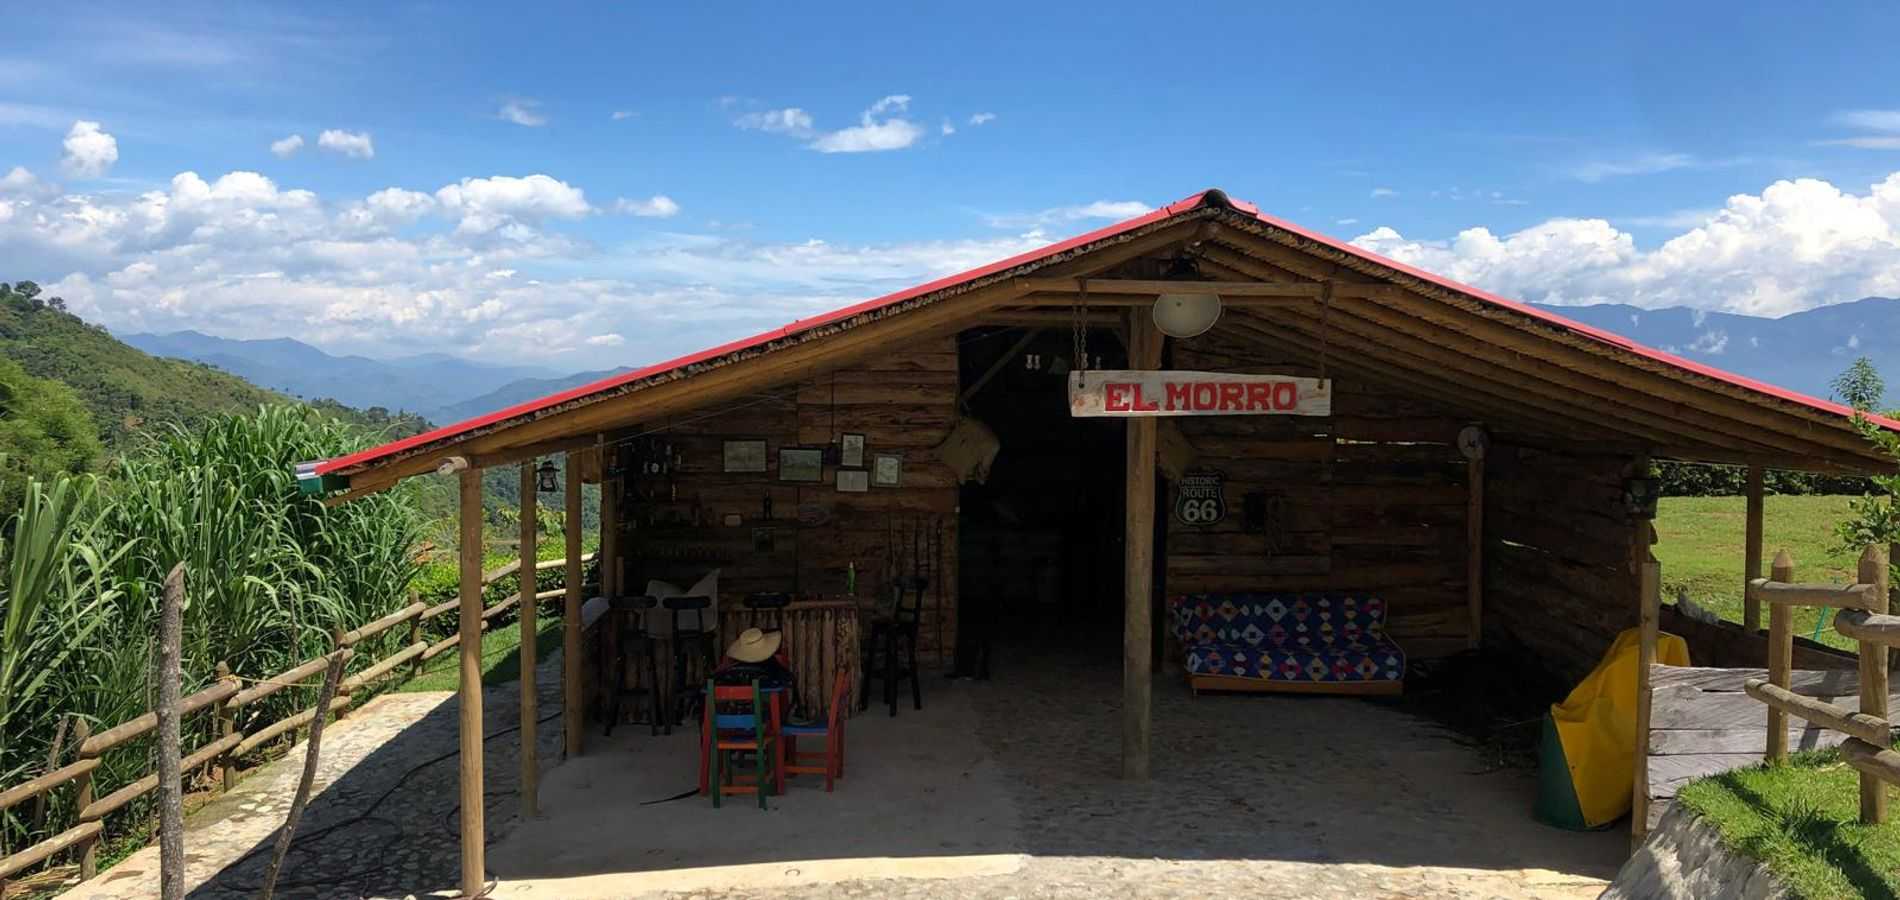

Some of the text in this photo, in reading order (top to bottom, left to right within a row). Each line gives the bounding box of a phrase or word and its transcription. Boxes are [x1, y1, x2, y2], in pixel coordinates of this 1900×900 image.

[1105, 382, 1297, 411] EL MORRO
[1182, 488, 1218, 498] ROUTE
[1183, 499, 1218, 521] 66
